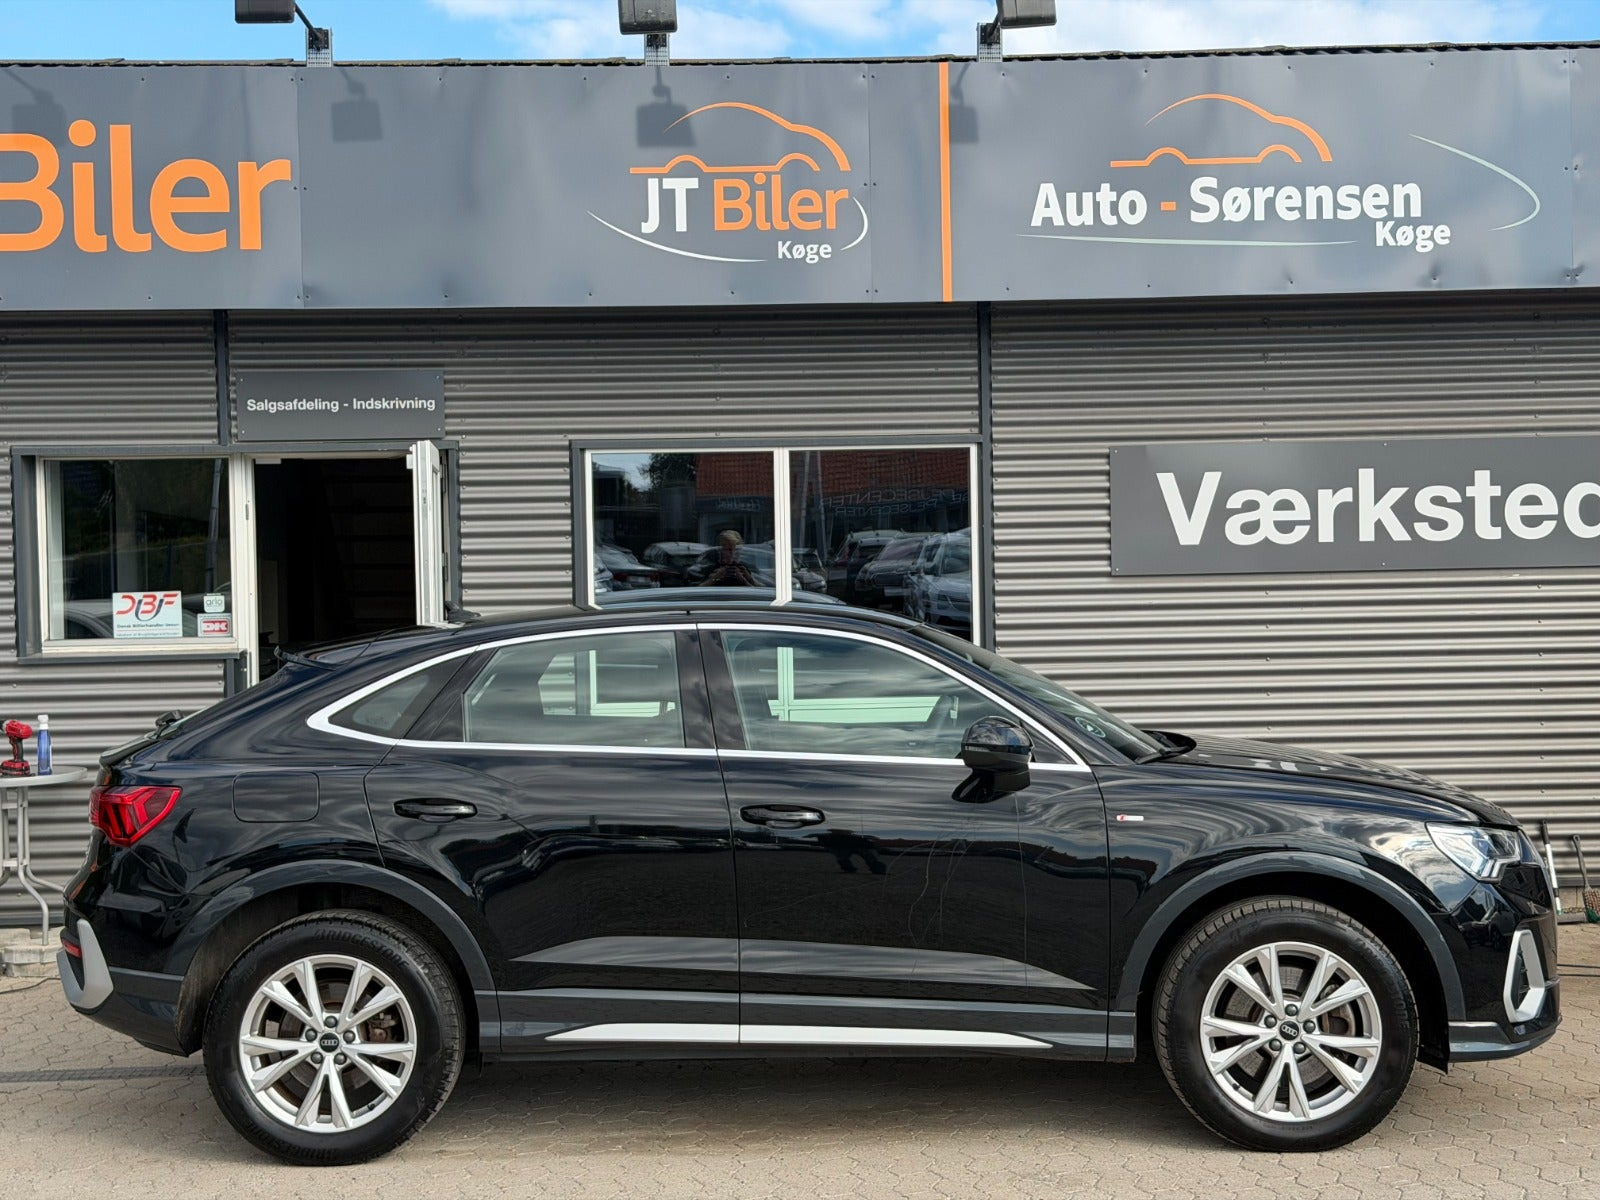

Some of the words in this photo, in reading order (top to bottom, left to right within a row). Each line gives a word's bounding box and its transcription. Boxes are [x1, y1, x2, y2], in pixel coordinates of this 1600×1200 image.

[0, 119, 291, 252] Biler
[641, 177, 699, 234] JT
[713, 172, 850, 231] Biler
[1030, 182, 1148, 227] Auto
[1160, 201, 1177, 211] -
[1189, 176, 1422, 223] Sørensen
[776, 239, 833, 264] Køge
[1375, 220, 1451, 253] Køge
[246, 398, 340, 413] Salgsafdeling
[352, 396, 436, 412] Indskrivning
